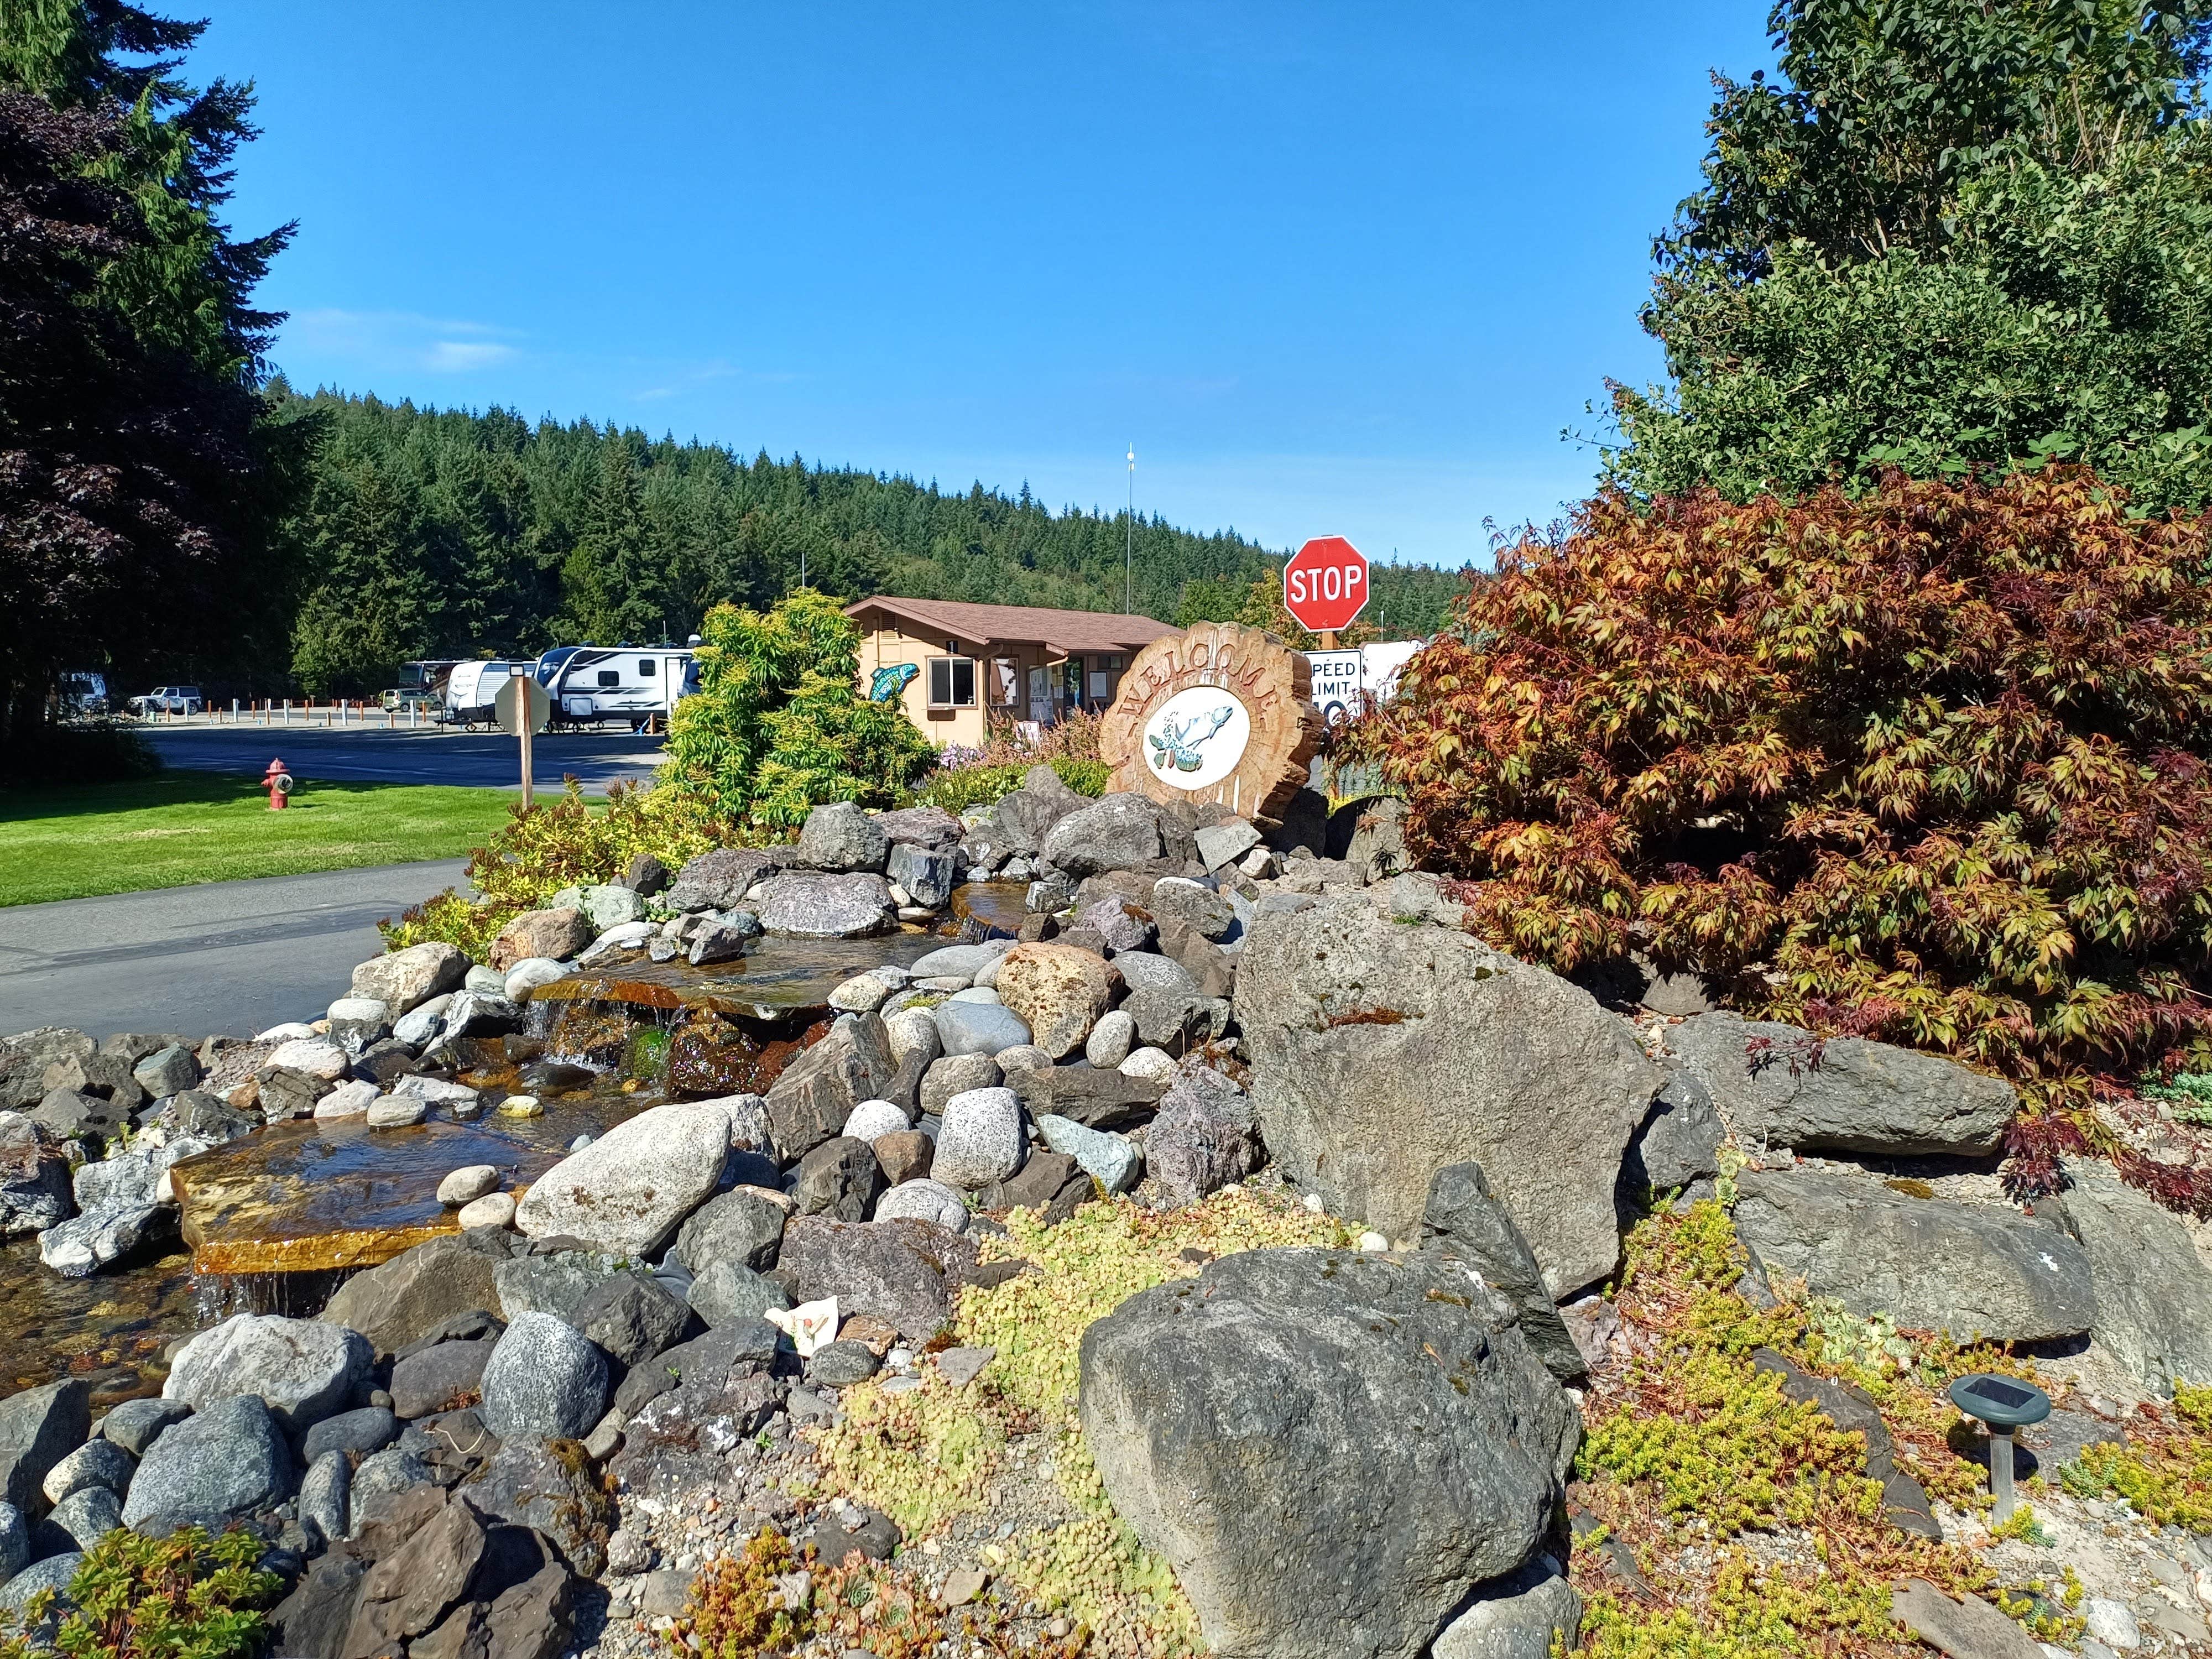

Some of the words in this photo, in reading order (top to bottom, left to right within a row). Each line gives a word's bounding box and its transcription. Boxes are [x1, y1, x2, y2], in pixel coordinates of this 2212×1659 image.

[1290, 565, 1362, 603] STOP
[950, 641, 954, 654] 1
[1117, 643, 1280, 718] WELCOME
[1312, 662, 1355, 676] PEED
